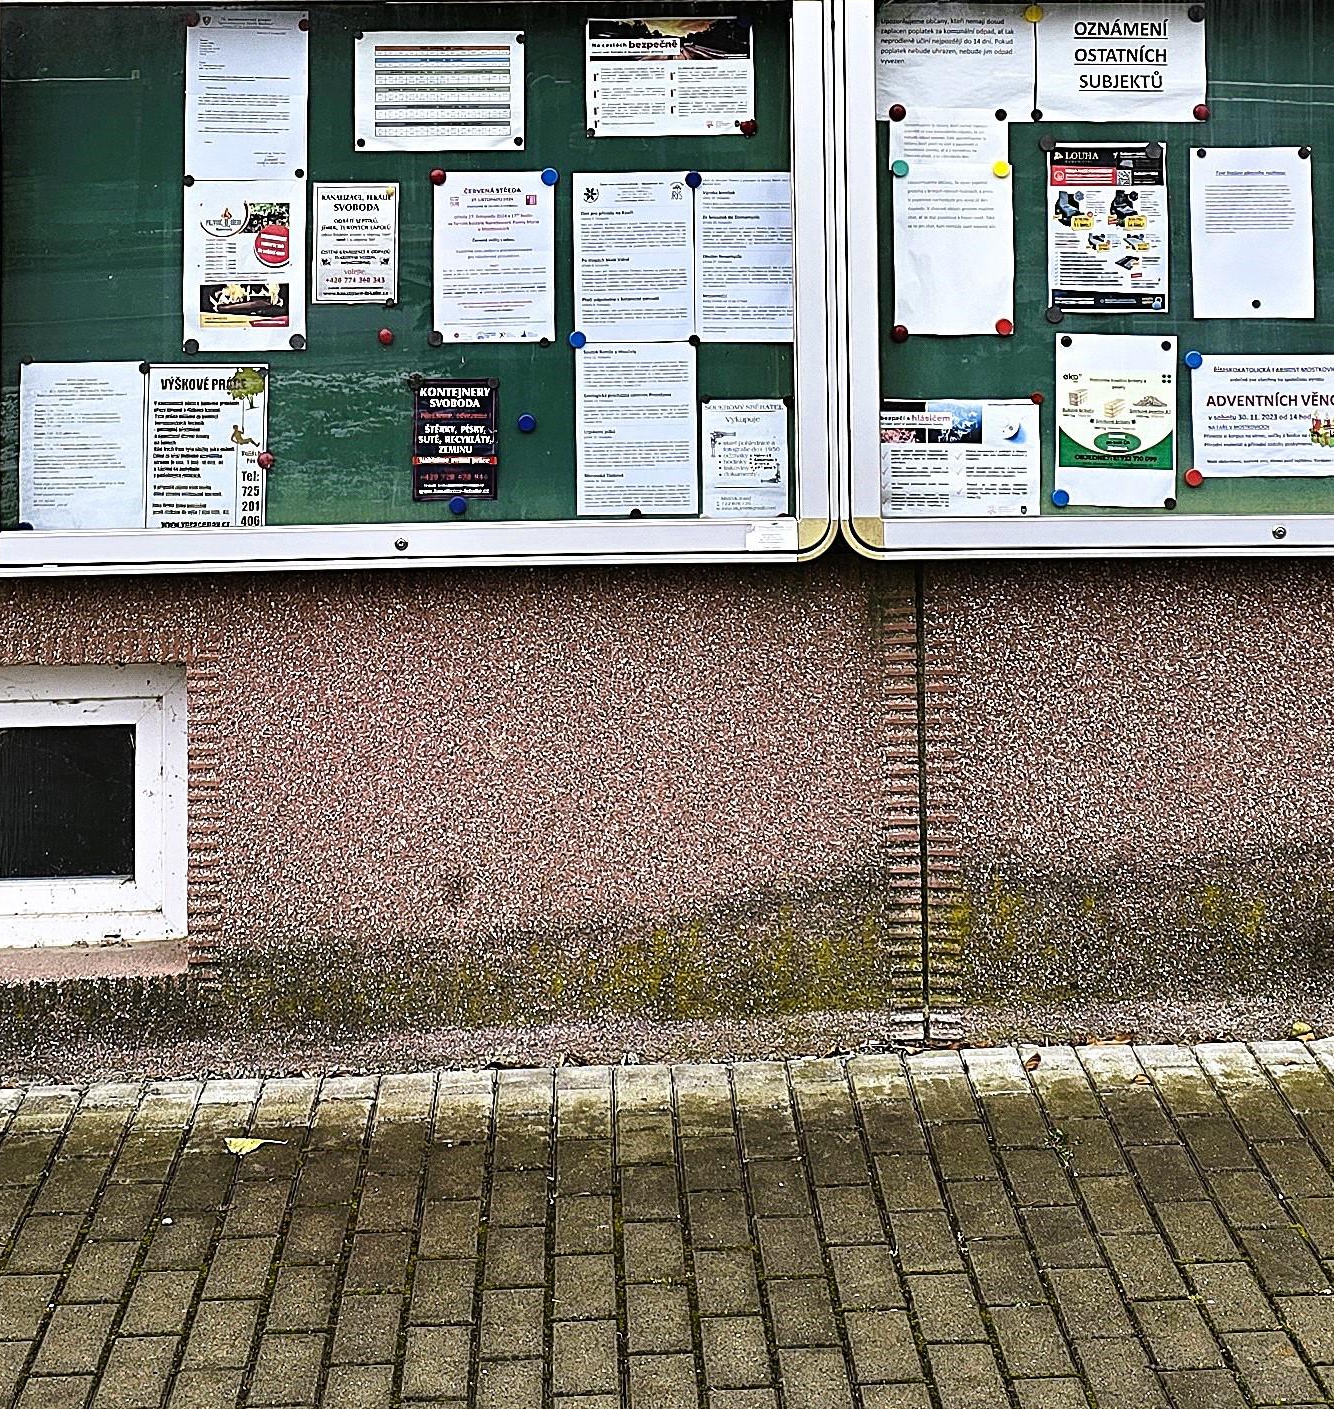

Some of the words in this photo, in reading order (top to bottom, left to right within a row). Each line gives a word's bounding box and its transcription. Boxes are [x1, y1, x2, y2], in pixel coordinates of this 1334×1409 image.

[1074, 19, 1169, 36] OZNÁMENÍ
[629, 40, 677, 50] bezpečně
[1075, 45, 1167, 62] OSTATNÍCH
[1080, 71, 1162, 88] SUBJEKTŮ
[1065, 152, 1099, 160] LOUHA
[161, 376, 209, 390] VÝŠKOVÉ
[420, 388, 490, 398] KONTEJNERY
[430, 399, 480, 408] SVOBODA
[1206, 392, 1298, 407] ADVENTNÍCH
[242, 471, 259, 482] Tel:
[242, 486, 259, 496] 725
[242, 501, 259, 511] 201
